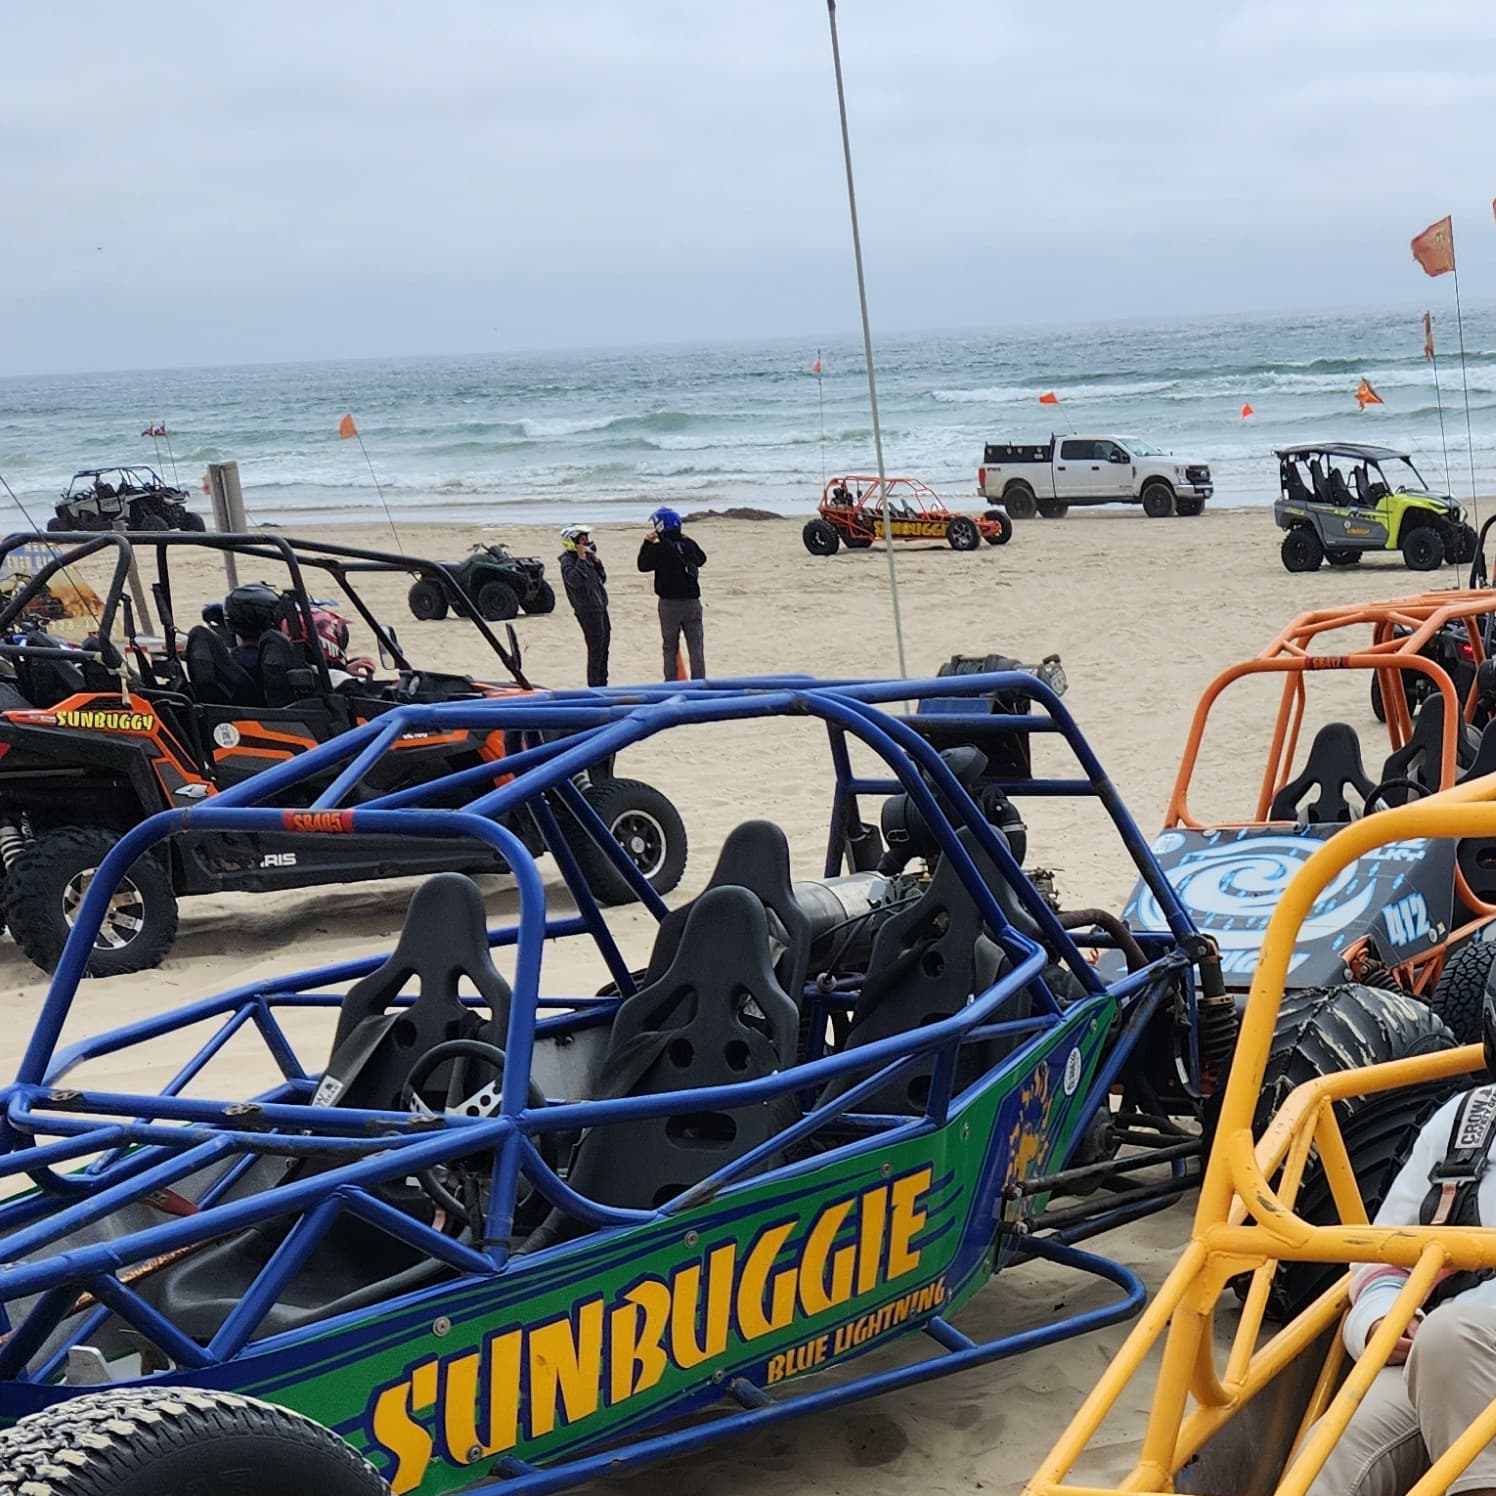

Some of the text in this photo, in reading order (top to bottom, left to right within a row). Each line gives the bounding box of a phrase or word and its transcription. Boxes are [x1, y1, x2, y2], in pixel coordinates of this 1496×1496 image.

[55, 711, 155, 731] SUNBUGGY
[1381, 892, 1431, 947] 412
[1461, 1100, 1489, 1145] CROW
[372, 1166, 933, 1495] SUNBUGGIE
[767, 1278, 946, 1385] BLUE LIGHTNING
